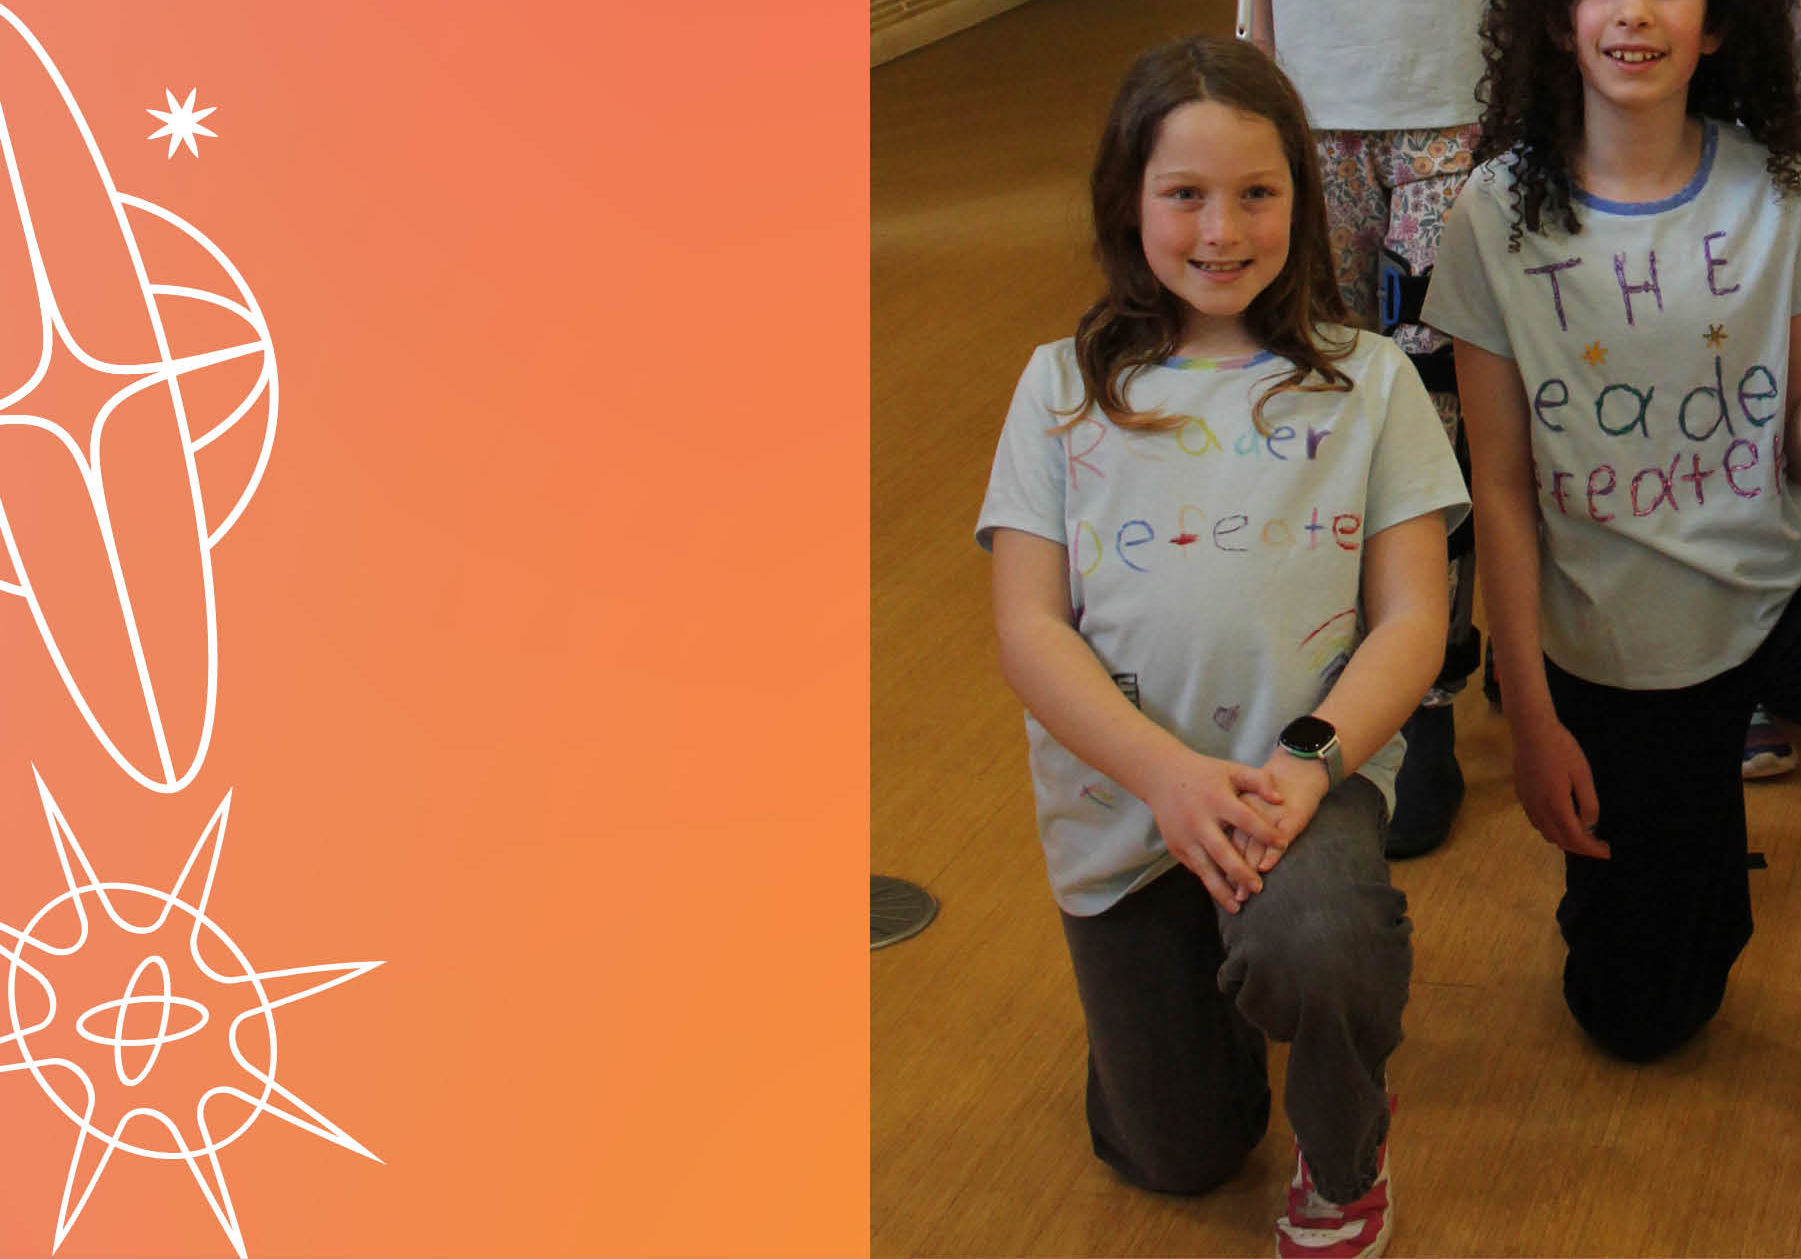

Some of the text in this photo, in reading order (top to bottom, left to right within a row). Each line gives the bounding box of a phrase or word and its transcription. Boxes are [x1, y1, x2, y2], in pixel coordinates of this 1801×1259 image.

[1524, 230, 1741, 331] THE
[1534, 355, 1779, 442] eade
[1073, 504, 1362, 578] Defeate
